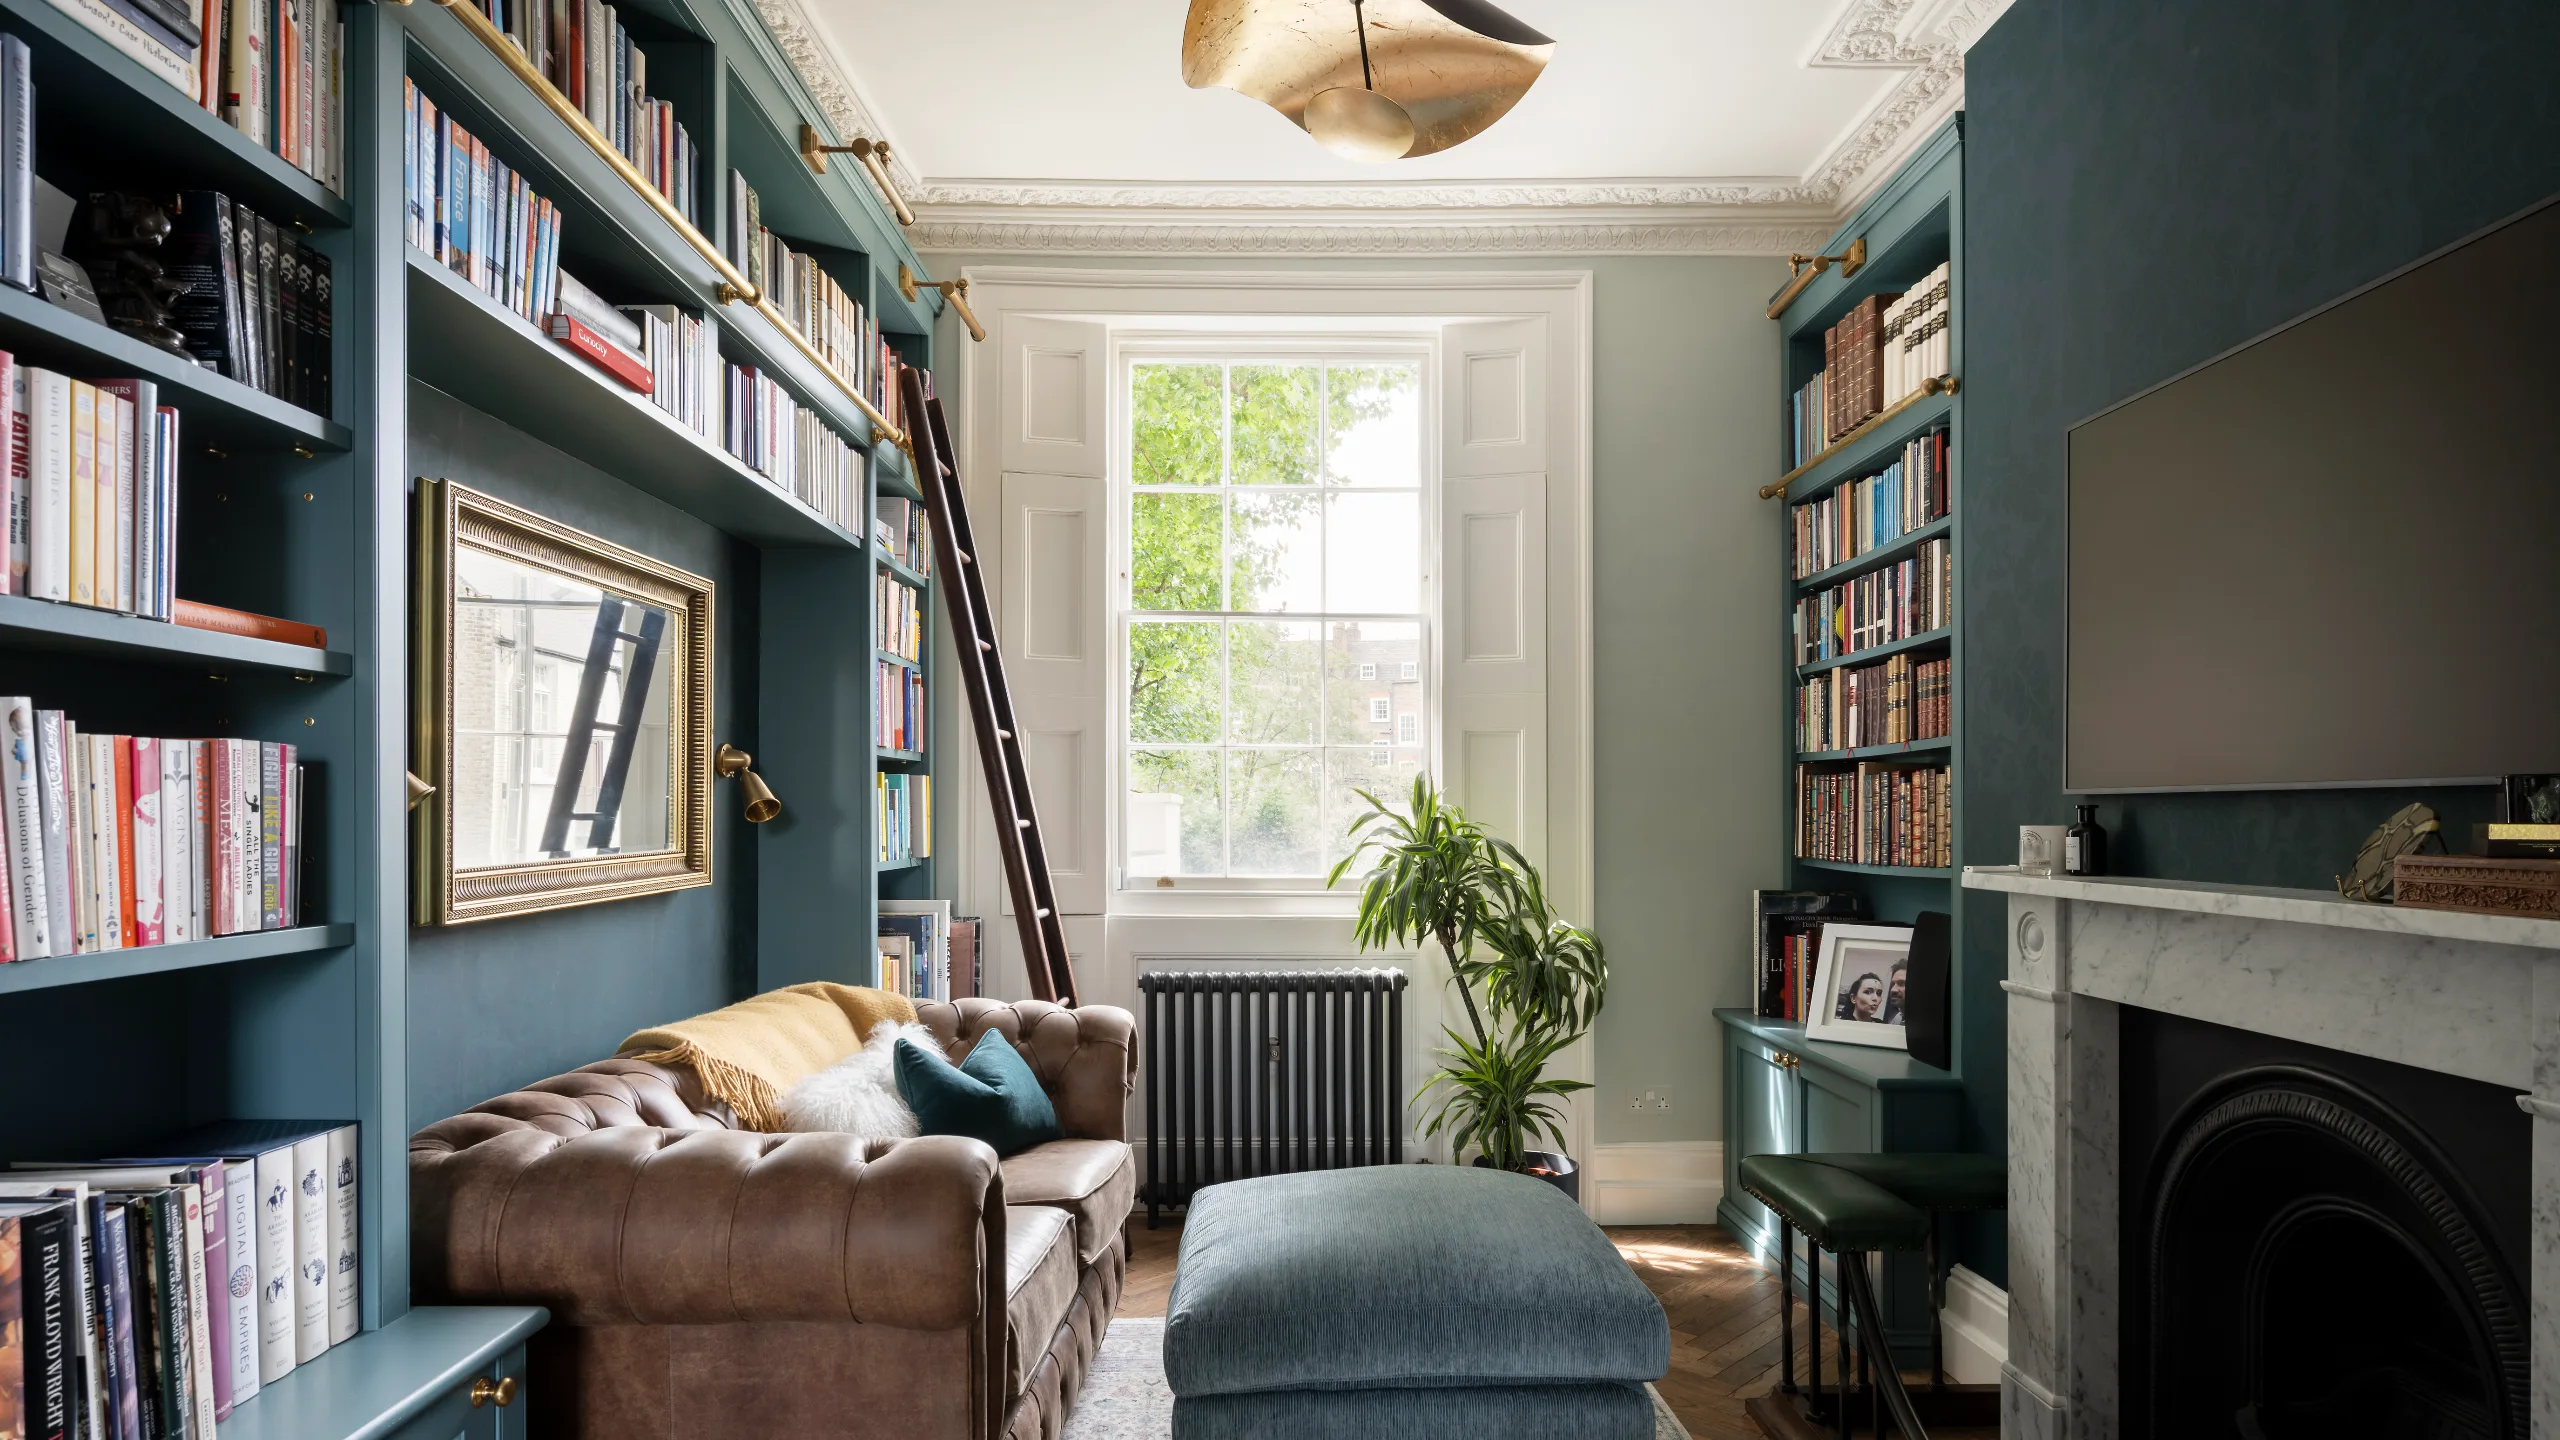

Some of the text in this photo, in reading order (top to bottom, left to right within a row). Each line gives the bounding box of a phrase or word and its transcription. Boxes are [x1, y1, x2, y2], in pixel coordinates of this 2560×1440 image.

[119, 24, 180, 74] Case Histories
[322, 41, 327, 49] OF
[592, 6, 600, 74] HITCHENS
[260, 73, 268, 110] Kennedy
[305, 79, 312, 88] IN
[16, 77, 25, 170] GRAMMAR RULES
[305, 114, 312, 122] OF
[424, 127, 436, 203] SPAIN
[472, 165, 481, 199] PARIS
[454, 157, 467, 222] France
[498, 188, 507, 232] Russia
[578, 328, 607, 356] Curiocity
[1, 368, 10, 394] Peter
[0, 396, 9, 426] Singer
[11, 410, 29, 479] EATING
[50, 385, 59, 507] MORAL TRIBES
[121, 430, 132, 462] NOAM
[121, 465, 132, 517] CHOMSKY
[10, 502, 18, 517] Jim
[20, 496, 28, 545] Peter Singer
[123, 555, 129, 565] OR
[210, 620, 252, 632] MACASKILL
[104, 778, 109, 786] OF
[196, 757, 209, 825] BEAUTY
[106, 815, 110, 823] IN
[176, 794, 185, 856] VAGINA
[220, 798, 232, 860] MEAT
[264, 747, 279, 882] FIGHT LIKE A GIRL
[16, 786, 36, 926] Delusions of Gender
[264, 883, 274, 910] FORD
[227, 1173, 251, 1187] BRADFORD
[338, 1194, 355, 1204] ARABIAN
[339, 1201, 354, 1211] NIGHTS
[164, 1202, 172, 1234] HISTORIC
[112, 1220, 124, 1254] Wood
[166, 1237, 176, 1261] ARTS
[43, 1242, 60, 1304] FRANK
[115, 1255, 127, 1293] Houses
[192, 1251, 202, 1270] 100
[80, 1236, 97, 1336] Art Deco Interiors
[168, 1270, 178, 1307] CRAFTS
[192, 1273, 204, 1321] Buildings
[236, 1194, 250, 1374] DIGITAL EMPIRES
[45, 1305, 63, 1359] LLOYD
[102, 1284, 117, 1378] prefabmodern
[171, 1308, 180, 1344] HOMES
[196, 1324, 205, 1341] 100
[197, 1342, 206, 1373] Years
[46, 1360, 63, 1429] WRIGHT
[232, 1381, 256, 1395] OXFORD
[144, 1414, 150, 1422] ST
